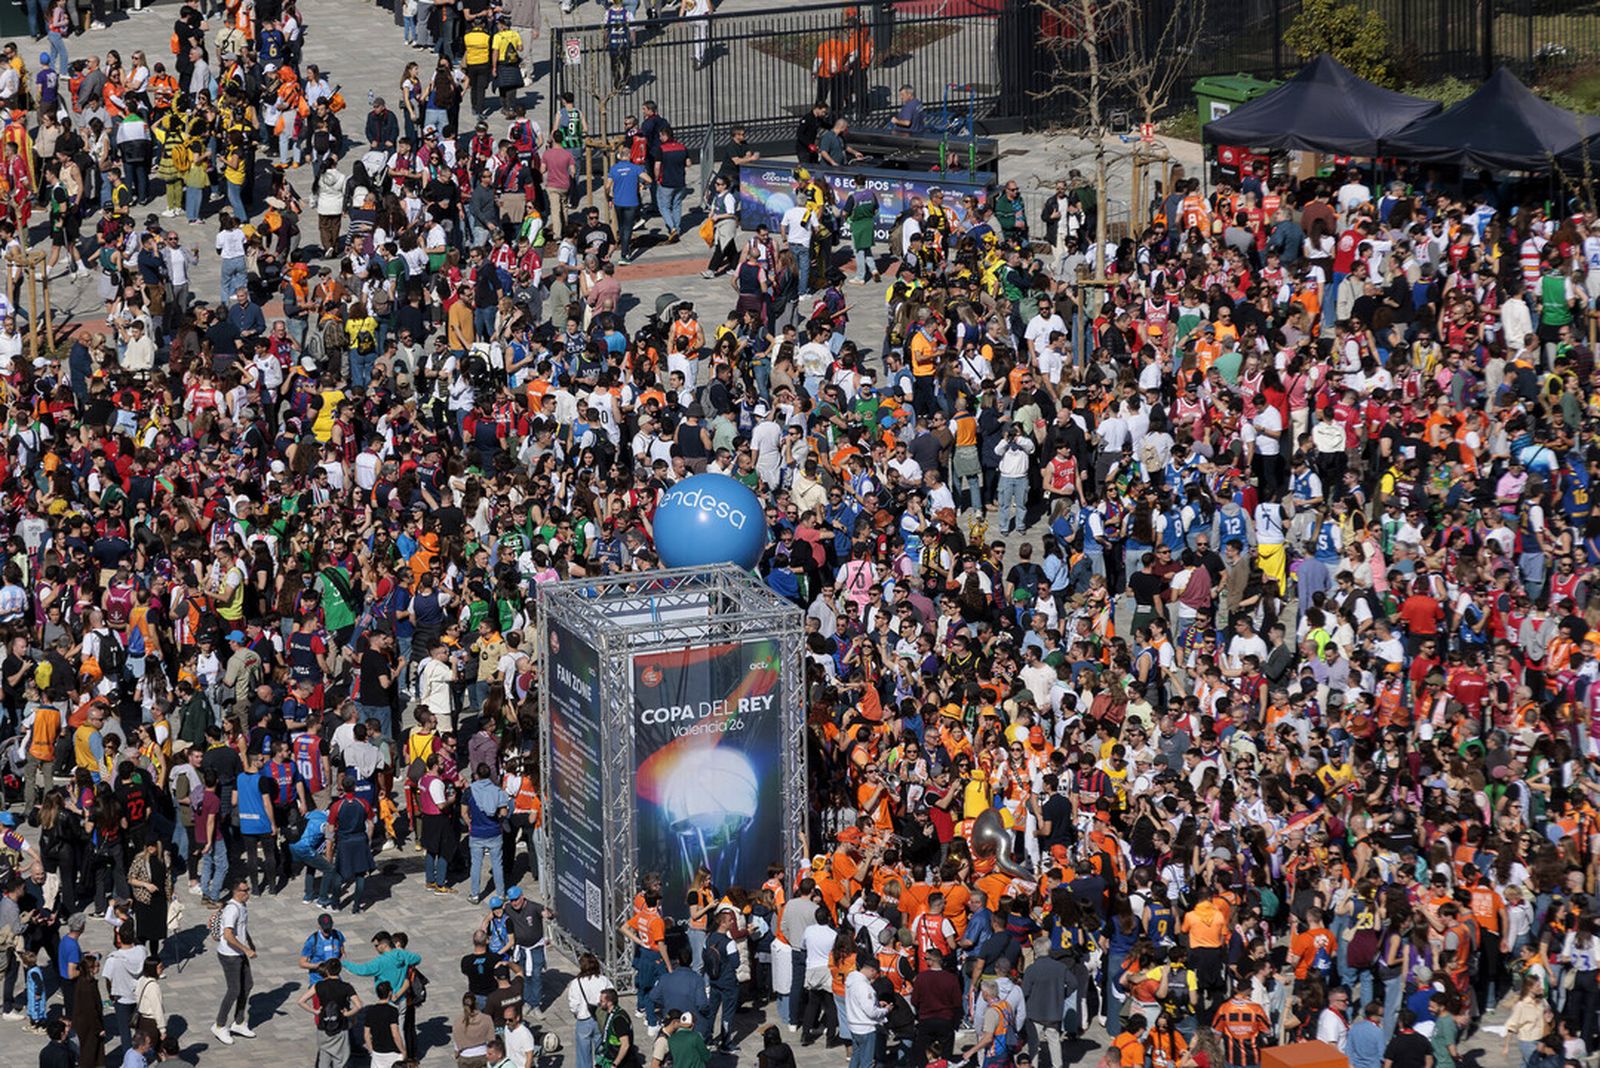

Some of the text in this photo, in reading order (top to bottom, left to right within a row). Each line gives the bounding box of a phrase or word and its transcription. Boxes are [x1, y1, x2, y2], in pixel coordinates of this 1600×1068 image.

[834, 178, 841, 187] 8
[660, 489, 747, 530] endesa
[1224, 518, 1241, 535] 12
[557, 663, 592, 703] FAN ZONE
[641, 694, 775, 725] COPA DEL REY
[1157, 919, 1167, 938] 9
[1356, 912, 1374, 931] 23
